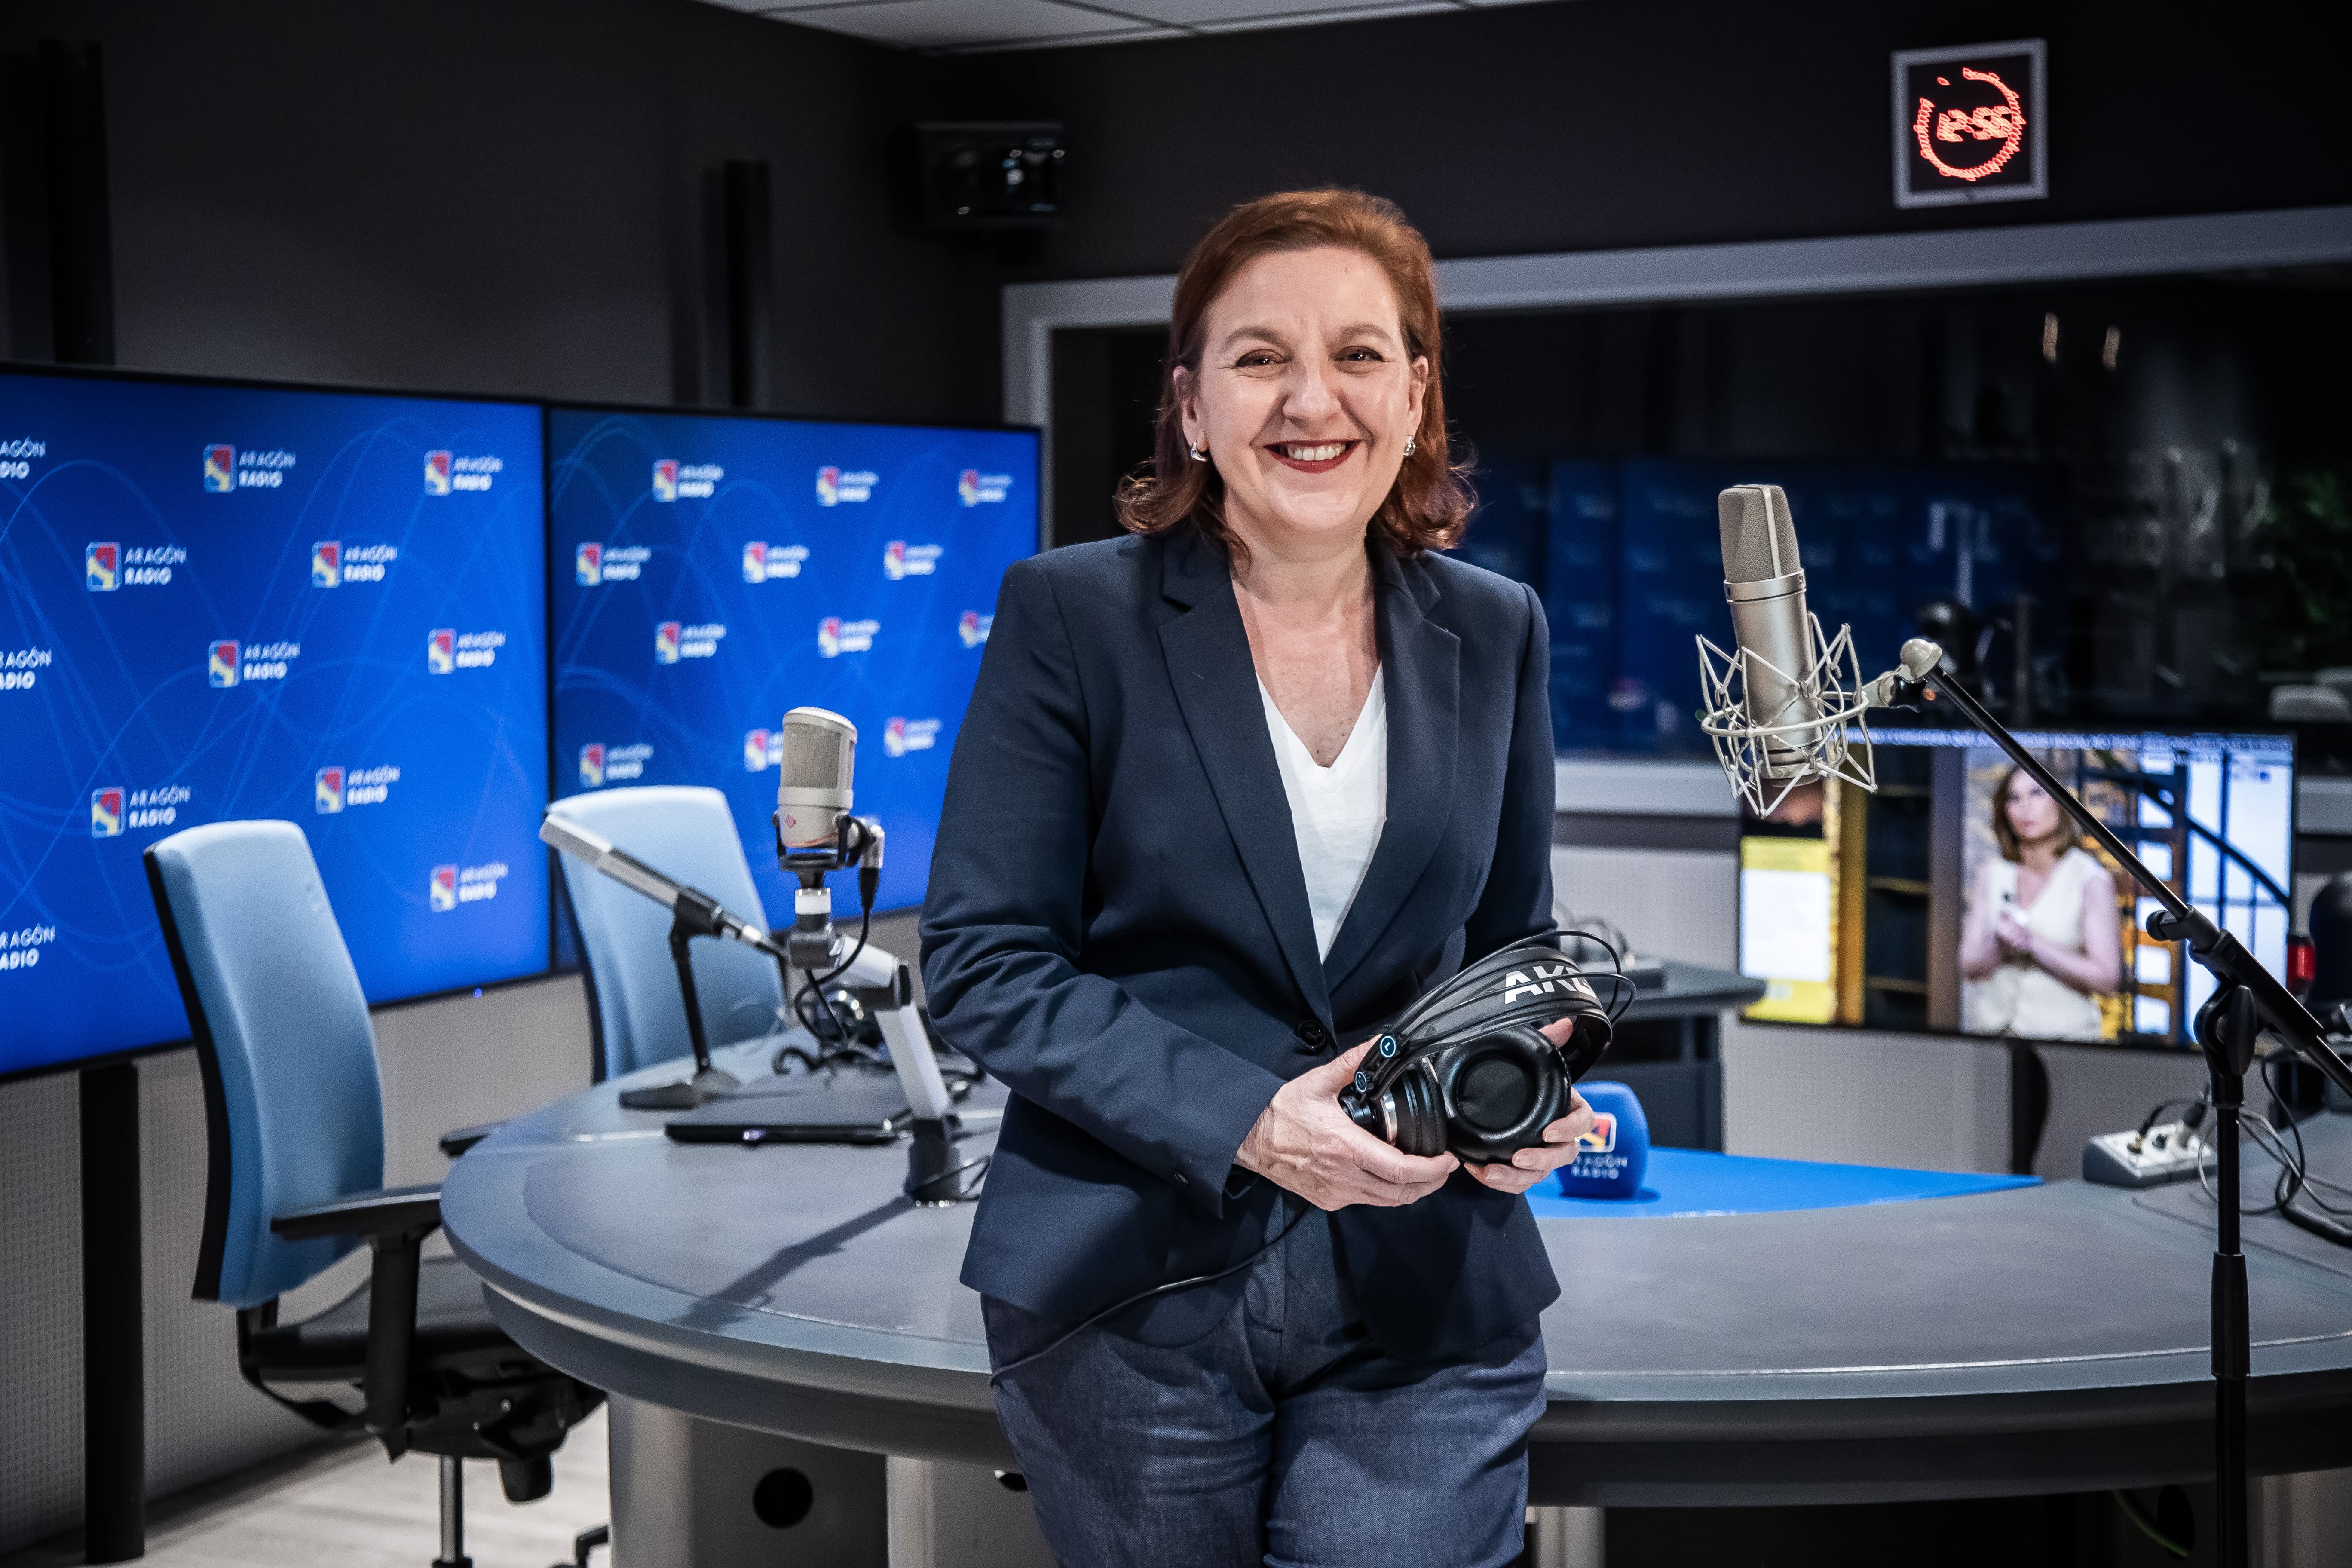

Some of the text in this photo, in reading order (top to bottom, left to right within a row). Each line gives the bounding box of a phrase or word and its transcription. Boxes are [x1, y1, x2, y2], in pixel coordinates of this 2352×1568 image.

[125, 543, 187, 564] ARAGÓN
[125, 567, 172, 585] RADIO
[129, 784, 191, 807] ARAGÓN
[129, 806, 176, 828] RADIO
